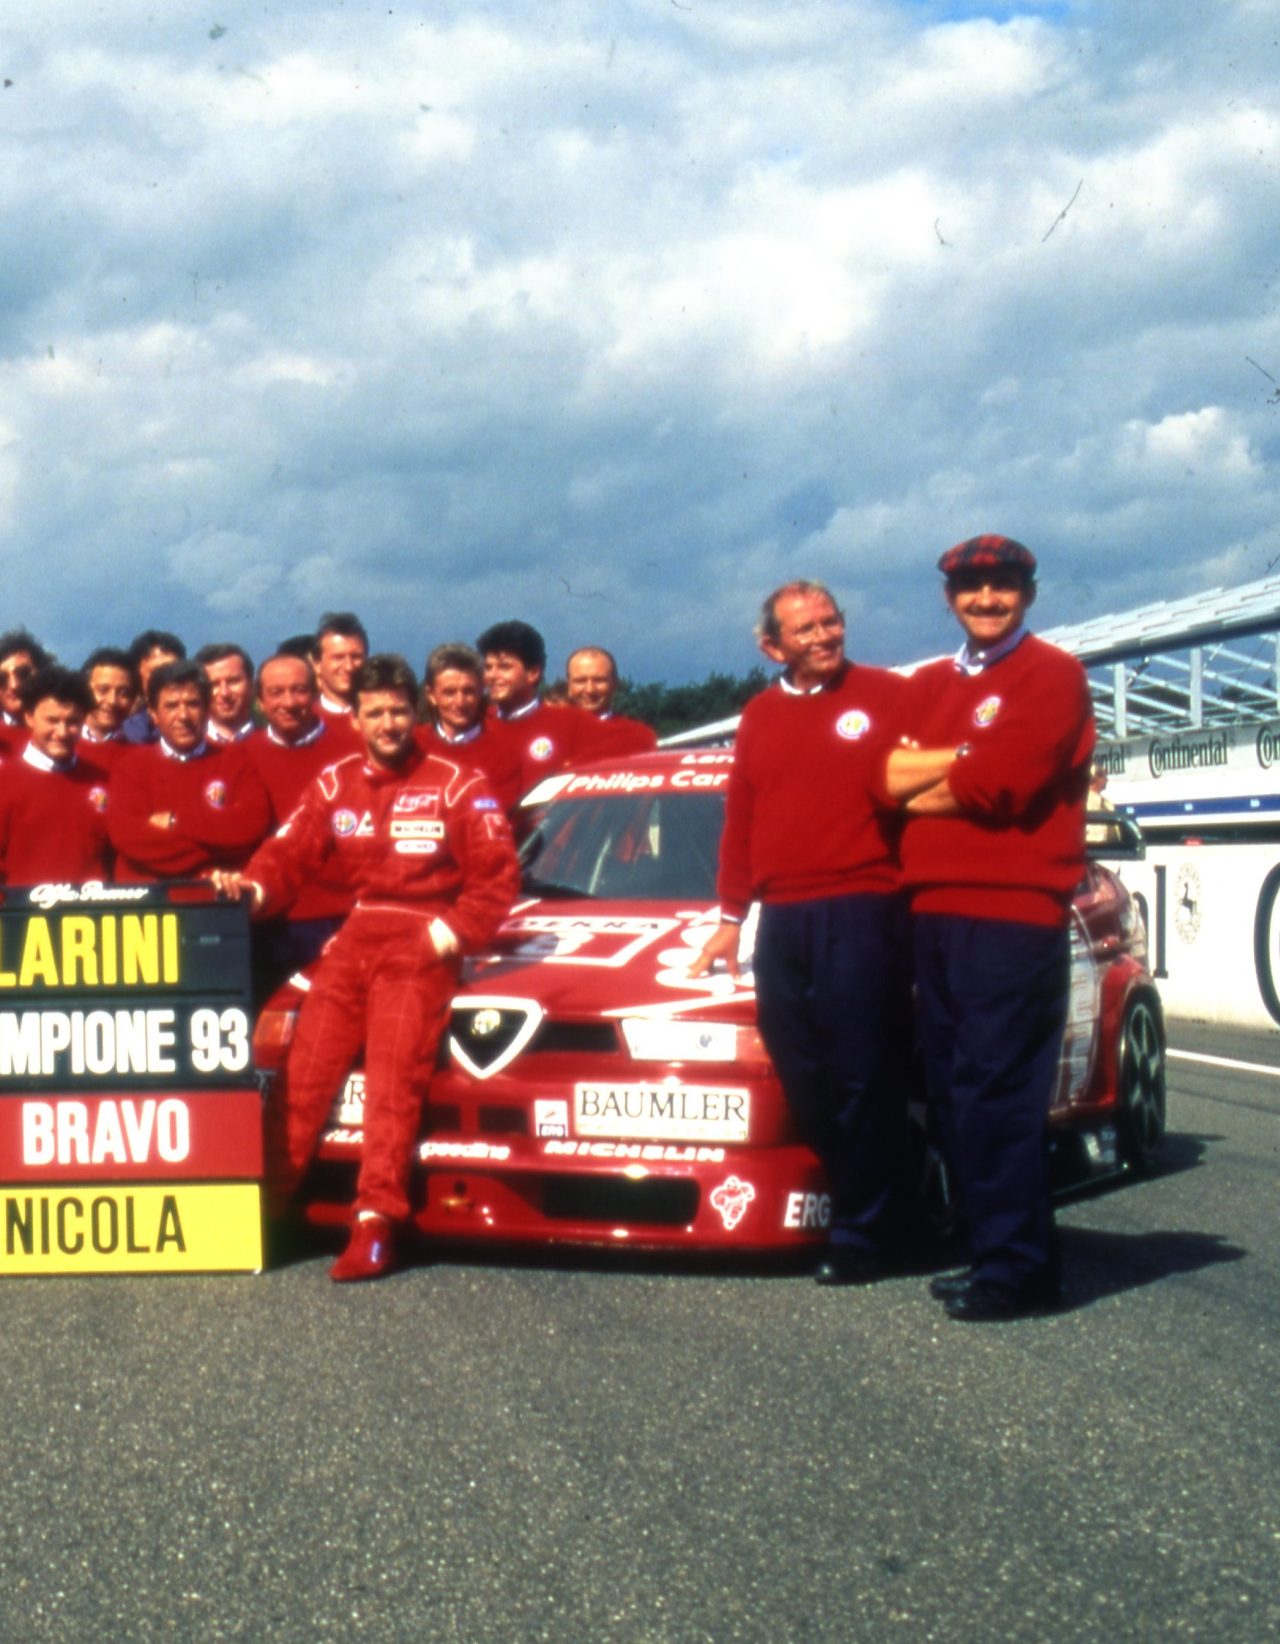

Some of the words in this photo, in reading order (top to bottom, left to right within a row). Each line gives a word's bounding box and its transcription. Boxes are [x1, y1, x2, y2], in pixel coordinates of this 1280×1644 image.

[1148, 731, 1228, 779] Continental
[566, 772, 665, 793] Philips
[671, 769, 730, 787] Car
[29, 883, 80, 909] Alfa
[80, 880, 150, 902] Romeo
[190, 1007, 250, 1072] 93
[580, 1089, 746, 1122] BAUMLER
[22, 1098, 190, 1166] BRAVO
[543, 1140, 726, 1163] MICHELIN
[5, 1194, 187, 1255] NICOLA
[784, 1192, 832, 1228] ERG
